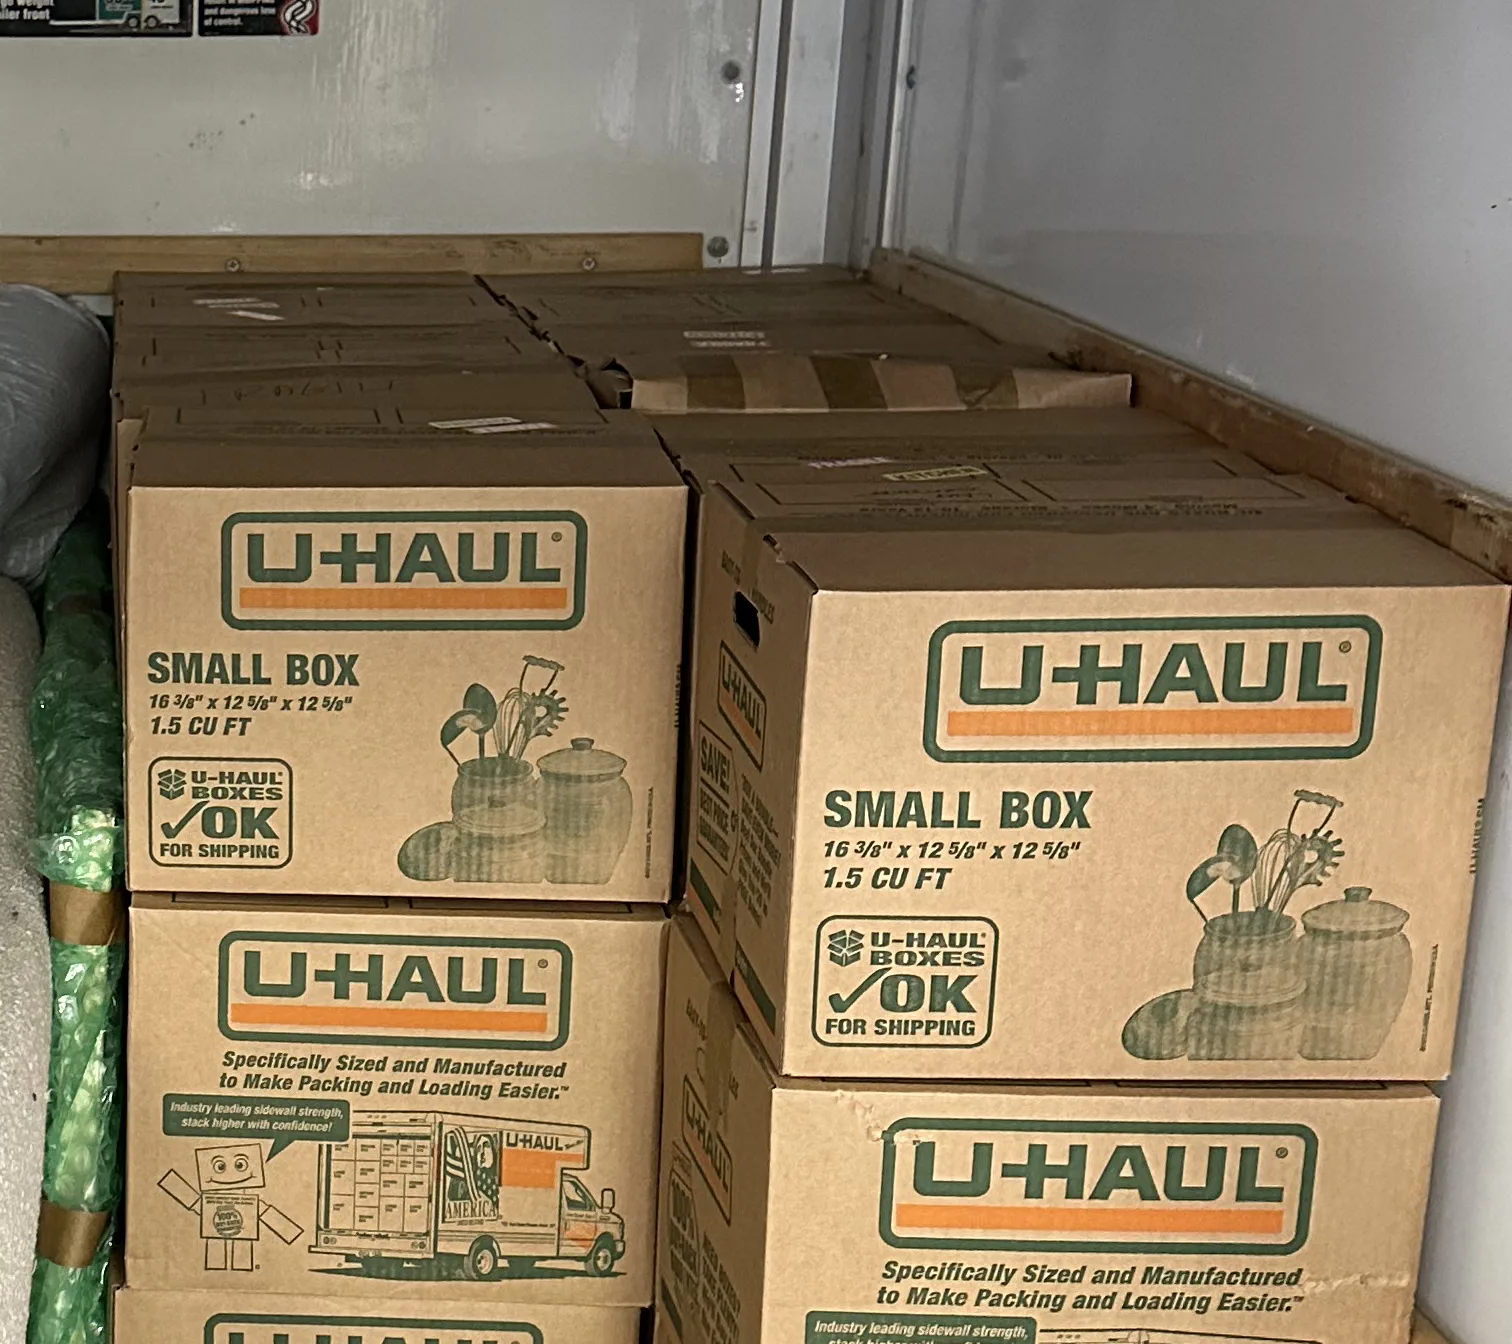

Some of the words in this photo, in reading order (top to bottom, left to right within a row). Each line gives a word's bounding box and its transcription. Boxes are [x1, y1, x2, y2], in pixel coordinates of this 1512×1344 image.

[23, 8, 50, 20] front
[147, 651, 272, 685] SMALL
[286, 653, 361, 686] BOX
[149, 694, 170, 709] 16
[172, 694, 204, 710] 3/8"
[207, 697, 219, 710] x
[223, 695, 244, 710] 12
[247, 695, 278, 711] 5/8"
[280, 698, 292, 711] x
[298, 696, 318, 711] 12
[322, 696, 353, 712] 5/8"
[151, 716, 182, 735] 1.5
[188, 716, 218, 736] CU
[223, 717, 252, 736] FT
[700, 735, 731, 795] SAVE!
[191, 786, 284, 800] BOXES
[823, 789, 982, 829] SMALL
[999, 790, 1094, 829] BOX
[201, 805, 280, 840] OK
[160, 843, 193, 857] FOR
[198, 844, 279, 859] SHIPPING
[824, 840, 850, 858] 16
[854, 840, 893, 859] 3/8"
[896, 844, 912, 859] x
[918, 841, 944, 859] 12
[948, 841, 988, 860] 5/8"
[990, 845, 1006, 860] x
[1012, 842, 1038, 860] 12
[1042, 841, 1081, 860] 5/8"
[823, 866, 863, 888] 1.5
[871, 867, 909, 889] CU
[914, 867, 953, 890] FT
[870, 950, 985, 967] BOXES
[879, 973, 978, 1013] OK
[825, 1018, 867, 1035] FOR
[874, 1018, 976, 1036] SHIPPING
[222, 1050, 331, 1073] Specifically
[335, 1055, 390, 1073] Sized
[392, 1057, 428, 1074] and
[433, 1058, 567, 1079] Manufactured
[219, 1073, 238, 1089] to
[243, 1073, 293, 1091] Make
[298, 1075, 373, 1097] Packing
[378, 1077, 414, 1096] and
[418, 1079, 491, 1100] Loading
[170, 1101, 213, 1115] Industry
[214, 1102, 252, 1116] leading
[253, 1103, 297, 1117] sidewall
[298, 1105, 344, 1119] strength,
[181, 1117, 210, 1128] stack
[212, 1118, 245, 1131] higher
[247, 1119, 270, 1130] with
[271, 1120, 333, 1132] confidence!
[505, 1131, 564, 1151] U-HAUL
[445, 1199, 497, 1219] AMERICA
[882, 1260, 1016, 1283] Specifically
[1022, 1263, 1085, 1285] Sized
[1090, 1266, 1135, 1285] and
[1141, 1265, 1304, 1287] Manufactured
[876, 1286, 900, 1304] to
[906, 1287, 968, 1307] Make
[974, 1288, 1065, 1312] Packing
[1072, 1290, 1115, 1310] and
[1121, 1291, 1212, 1314] Loading
[814, 1320, 866, 1335] Industry
[869, 1321, 915, 1337] leading
[917, 1322, 971, 1337] sidewall
[973, 1324, 1029, 1341] strength,
